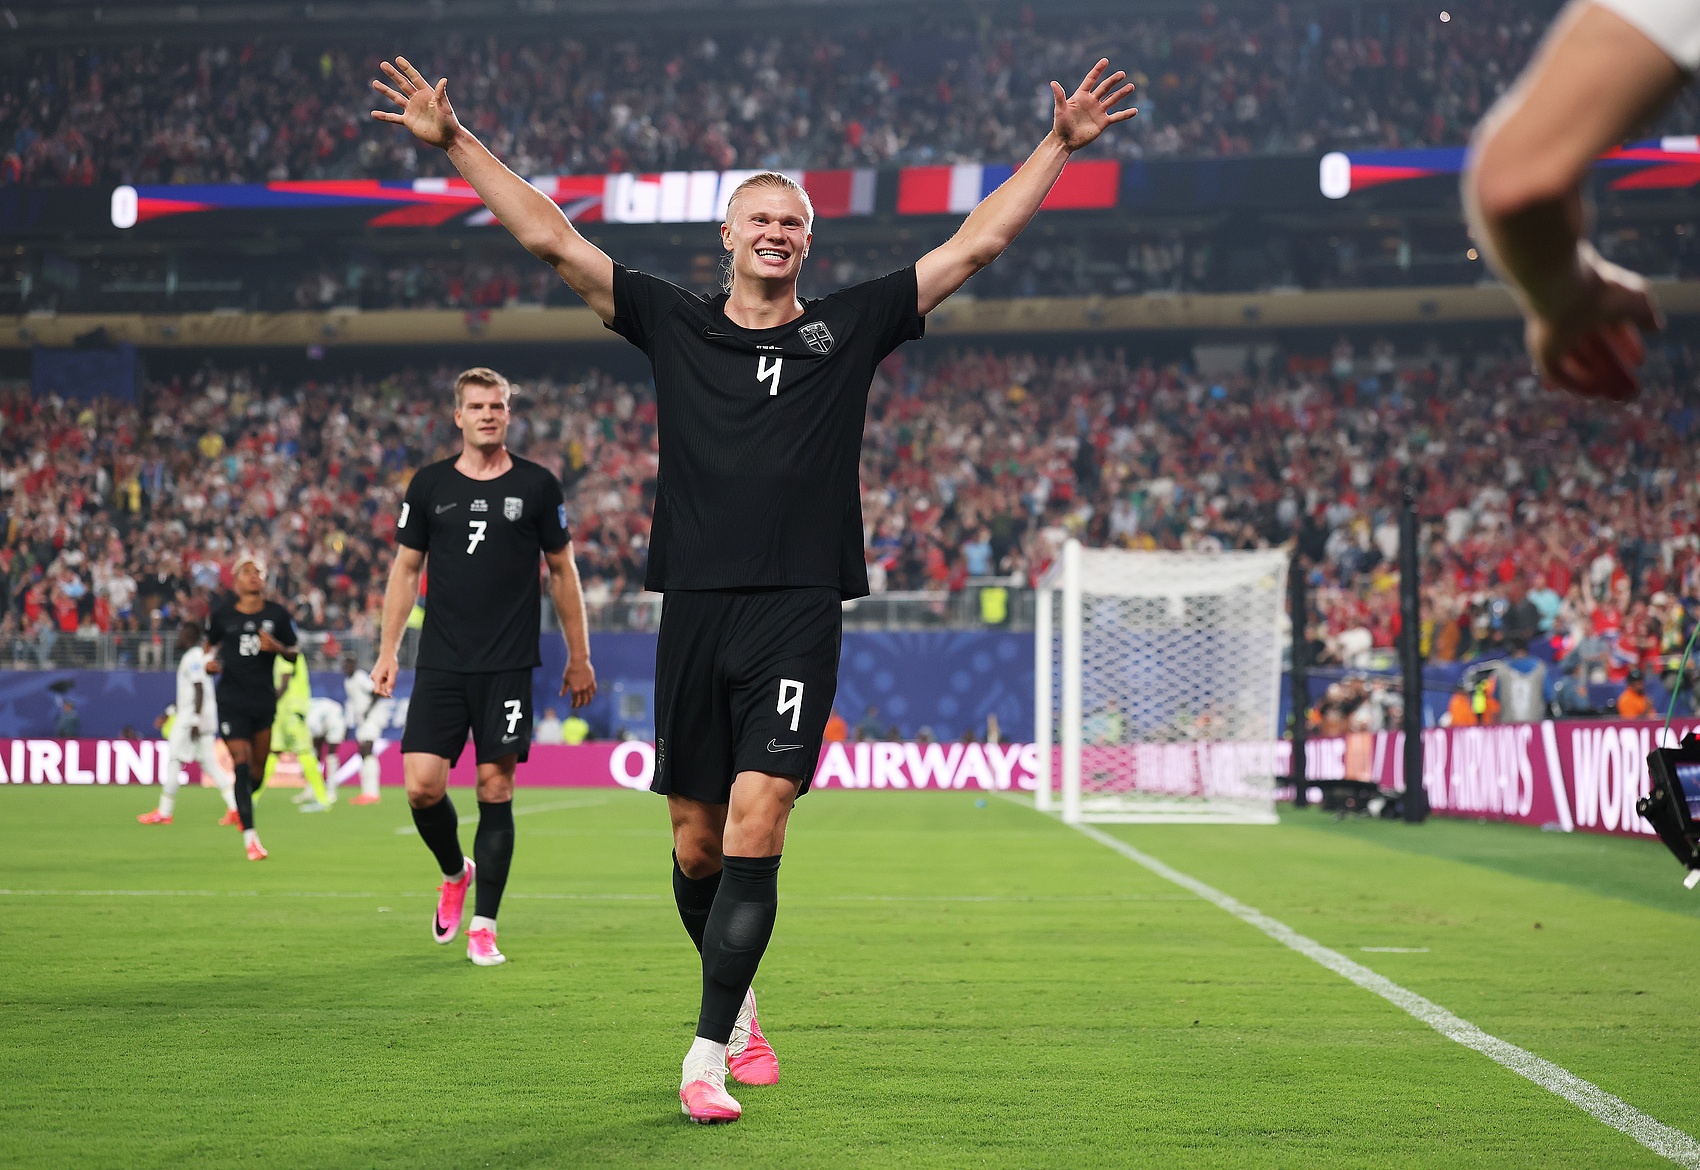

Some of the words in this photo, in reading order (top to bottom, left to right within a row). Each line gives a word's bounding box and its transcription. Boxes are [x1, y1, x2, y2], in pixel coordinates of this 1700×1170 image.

[467, 520, 487, 554] 7
[504, 699, 523, 734] 7
[776, 678, 805, 731] 9
[0, 739, 190, 785] IRLIN
[814, 741, 1039, 790] AIRWAYS
